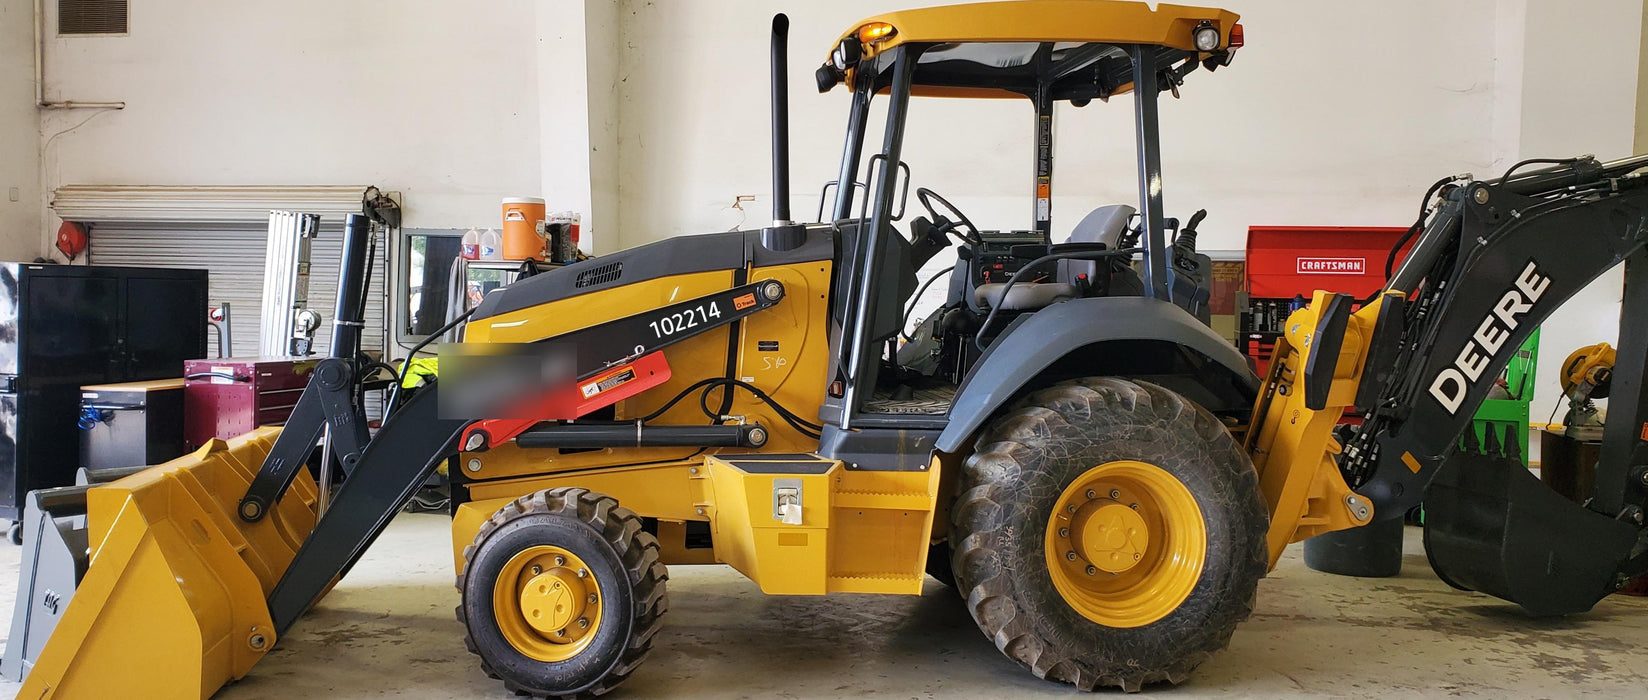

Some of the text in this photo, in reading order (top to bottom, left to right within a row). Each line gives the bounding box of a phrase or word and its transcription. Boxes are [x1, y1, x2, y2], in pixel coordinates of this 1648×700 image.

[1301, 261, 1361, 270] CRAFTSMAN
[649, 301, 722, 338] 102214
[1428, 261, 1551, 415] DEERE
